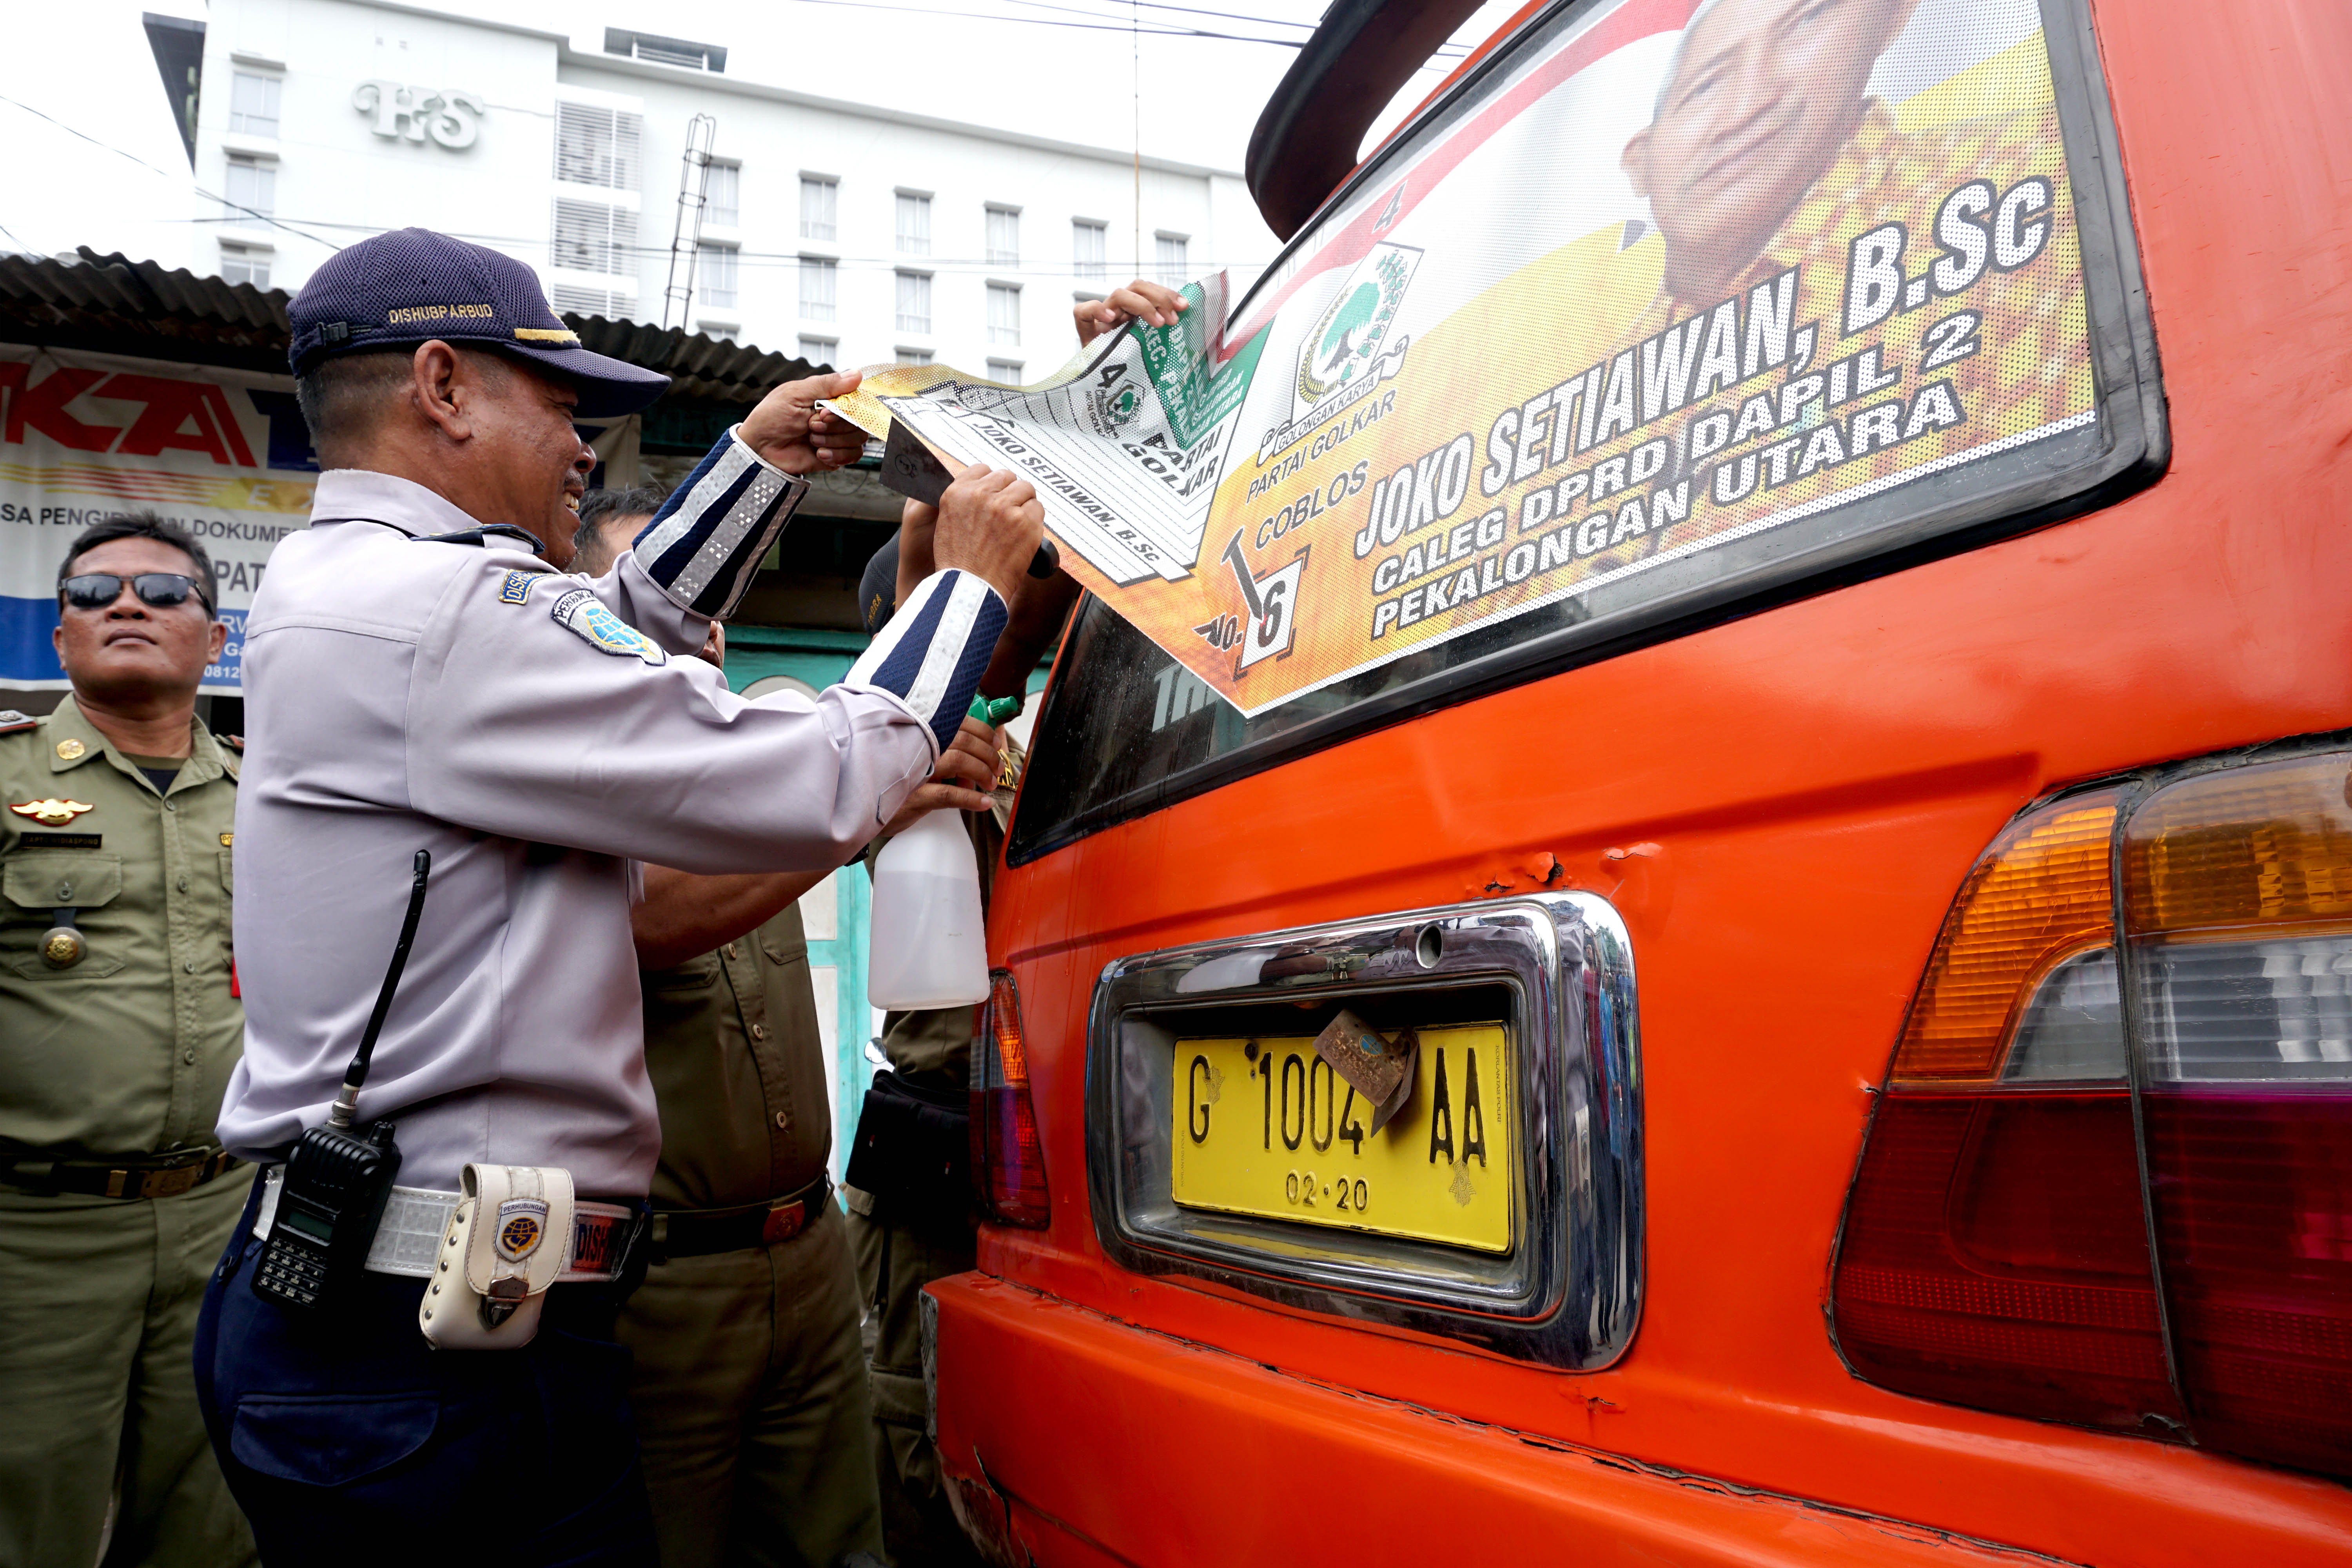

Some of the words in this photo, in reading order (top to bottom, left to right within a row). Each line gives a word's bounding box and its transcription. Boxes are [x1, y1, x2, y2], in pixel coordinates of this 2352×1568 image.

[1372, 180, 1408, 234] 4
[1098, 363, 1127, 388] 4
[1279, 403, 1336, 449] GOLONGAN
[1337, 376, 1374, 410] KARYA
[1354, 432, 1474, 559] JOKO
[1481, 265, 1819, 497] SETIAWAN,
[973, 423, 1026, 454] JOKO
[1021, 457, 1116, 527] SETIAWAN,
[1246, 445, 1308, 505] PARTAI
[1310, 388, 1396, 461] GOLKAR
[1372, 506, 1507, 596] CALEG
[1519, 436, 1670, 534] DPRD
[1687, 344, 1902, 465] DAPIL
[1920, 309, 1982, 373] 2
[1255, 459, 1368, 550] COBLOS
[1371, 477, 1693, 641] PEKALONGAN
[1710, 378, 1966, 508] UTARA
[1258, 580, 1286, 648] 6
[1189, 1054, 1210, 1144] G
[1259, 1052, 1363, 1155] 1004
[1429, 1047, 1487, 1167] AA
[503, 1203, 546, 1213] PERHUBUNGAN
